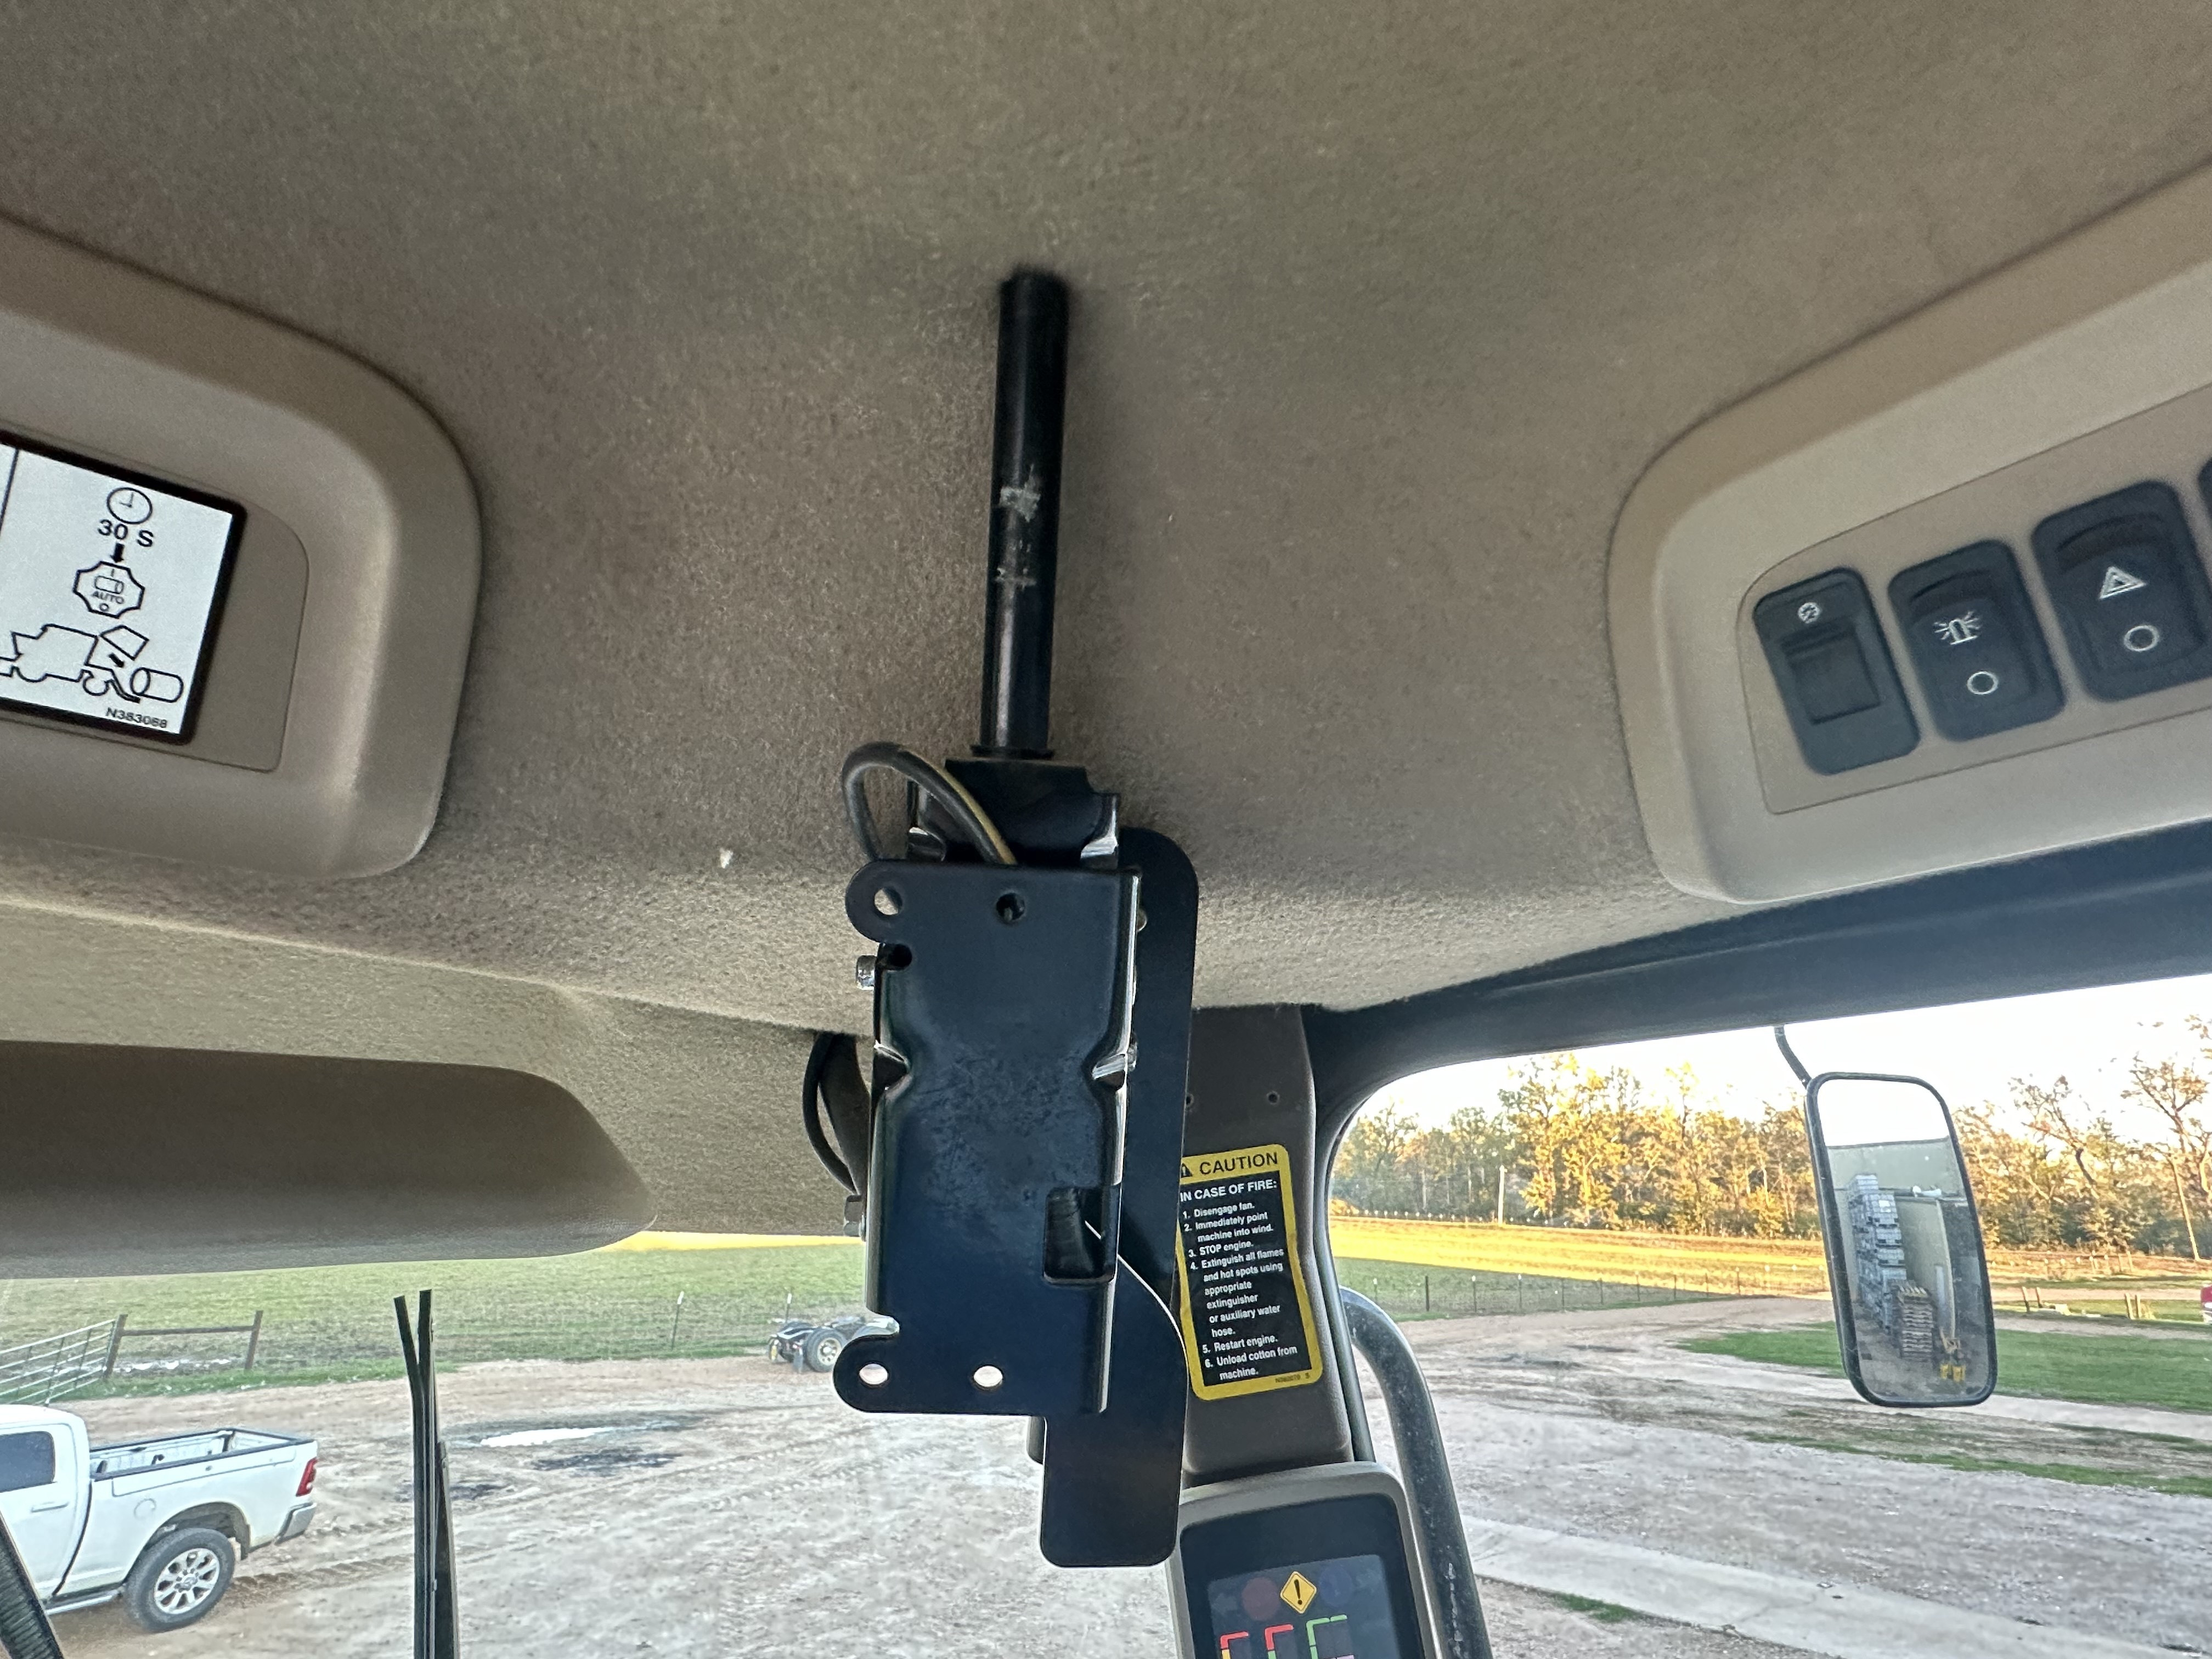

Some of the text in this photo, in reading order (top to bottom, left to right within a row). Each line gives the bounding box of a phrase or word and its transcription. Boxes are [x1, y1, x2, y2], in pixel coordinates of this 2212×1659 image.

[98, 519, 128, 540] 30
[92, 590, 124, 604] AUTO
[1199, 1152, 1277, 1175] CAUTION
[1180, 1179, 1277, 1202] IN CASE OF FIRE:
[1183, 1210, 1190, 1219] 1.
[1194, 1205, 1238, 1218] Disengage
[1184, 1211, 1268, 1232] 2. Immediately point
[1197, 1223, 1274, 1243] machine into wind.
[1188, 1240, 1254, 1257] 3. STOP engine.
[1190, 1248, 1284, 1270] 4. Extinguish all flames
[1204, 1262, 1284, 1282] and hot spots using
[1205, 1280, 1252, 1297] appropriate
[1207, 1294, 1259, 1310] extinguisher
[1209, 1305, 1280, 1323] or auxiliary water
[1211, 1327, 1236, 1338] hose.
[1202, 1334, 1279, 1354] 5. Restart engine.
[1205, 1346, 1298, 1368] 6. Unload cotton from
[1219, 1367, 1259, 1380] machine.
